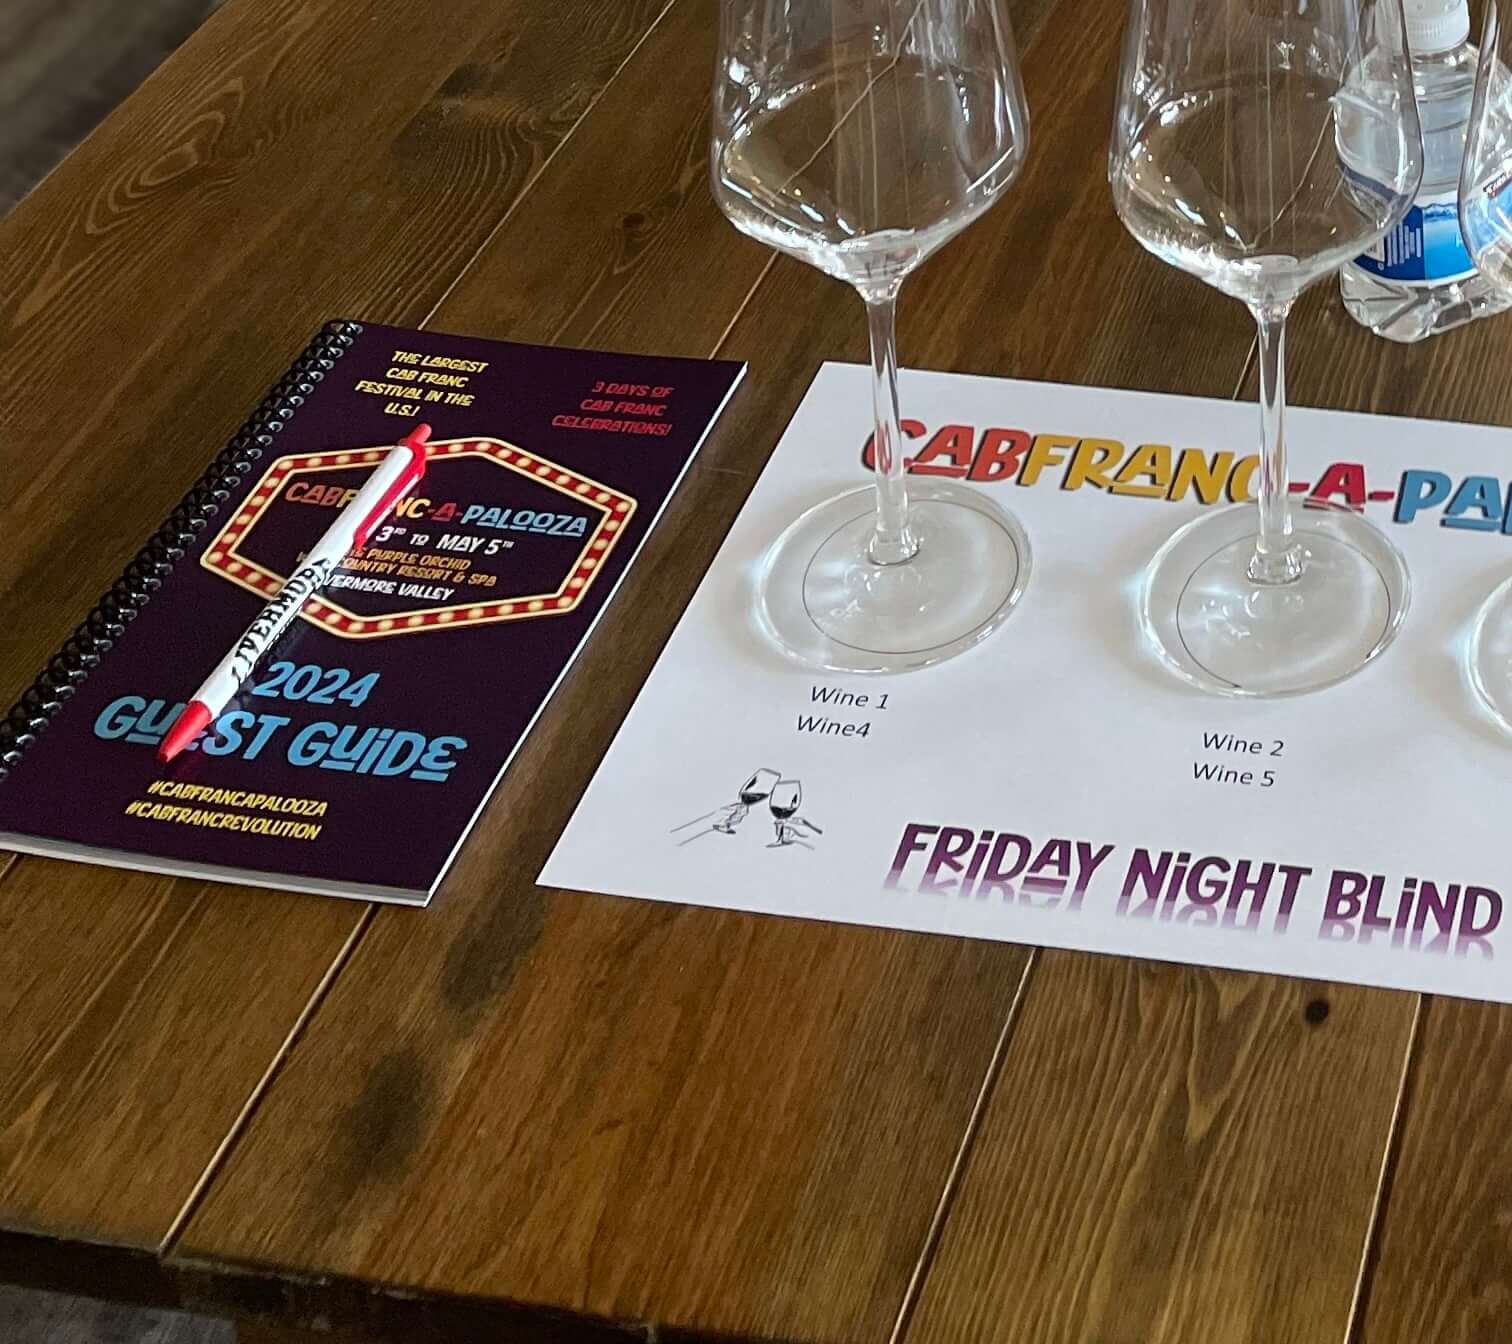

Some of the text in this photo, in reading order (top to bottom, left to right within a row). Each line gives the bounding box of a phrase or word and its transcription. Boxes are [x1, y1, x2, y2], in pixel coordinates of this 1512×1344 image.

[391, 350, 489, 375] THE LARGEST
[385, 366, 470, 389] CAB FRANC
[605, 382, 650, 398] DAYS
[354, 380, 476, 407] FESTIVAL IN THE
[384, 401, 421, 418] U.S.!
[579, 398, 668, 417] CAB FRANC
[551, 414, 674, 437] CELEBRATIONS!
[284, 481, 589, 538] CABFNC-A-PALOOZA
[435, 533, 486, 553] MAY
[340, 557, 399, 575] OUNTRY
[396, 564, 453, 581] RESORT
[467, 573, 498, 587] SPA
[366, 548, 420, 565] PURPLE
[419, 554, 472, 570] ORCHID
[398, 582, 455, 601] VALLEY
[251, 660, 381, 709] 2024
[810, 685, 889, 711] Wine 1
[93, 694, 292, 761] GUST
[796, 714, 872, 740] Wine4
[1202, 732, 1285, 758] Wine 2
[1192, 762, 1276, 789] Wine 5
[147, 779, 329, 818] #CABFRANCAPALOOZA
[124, 799, 323, 842] #CABFRANCREVOLUTION
